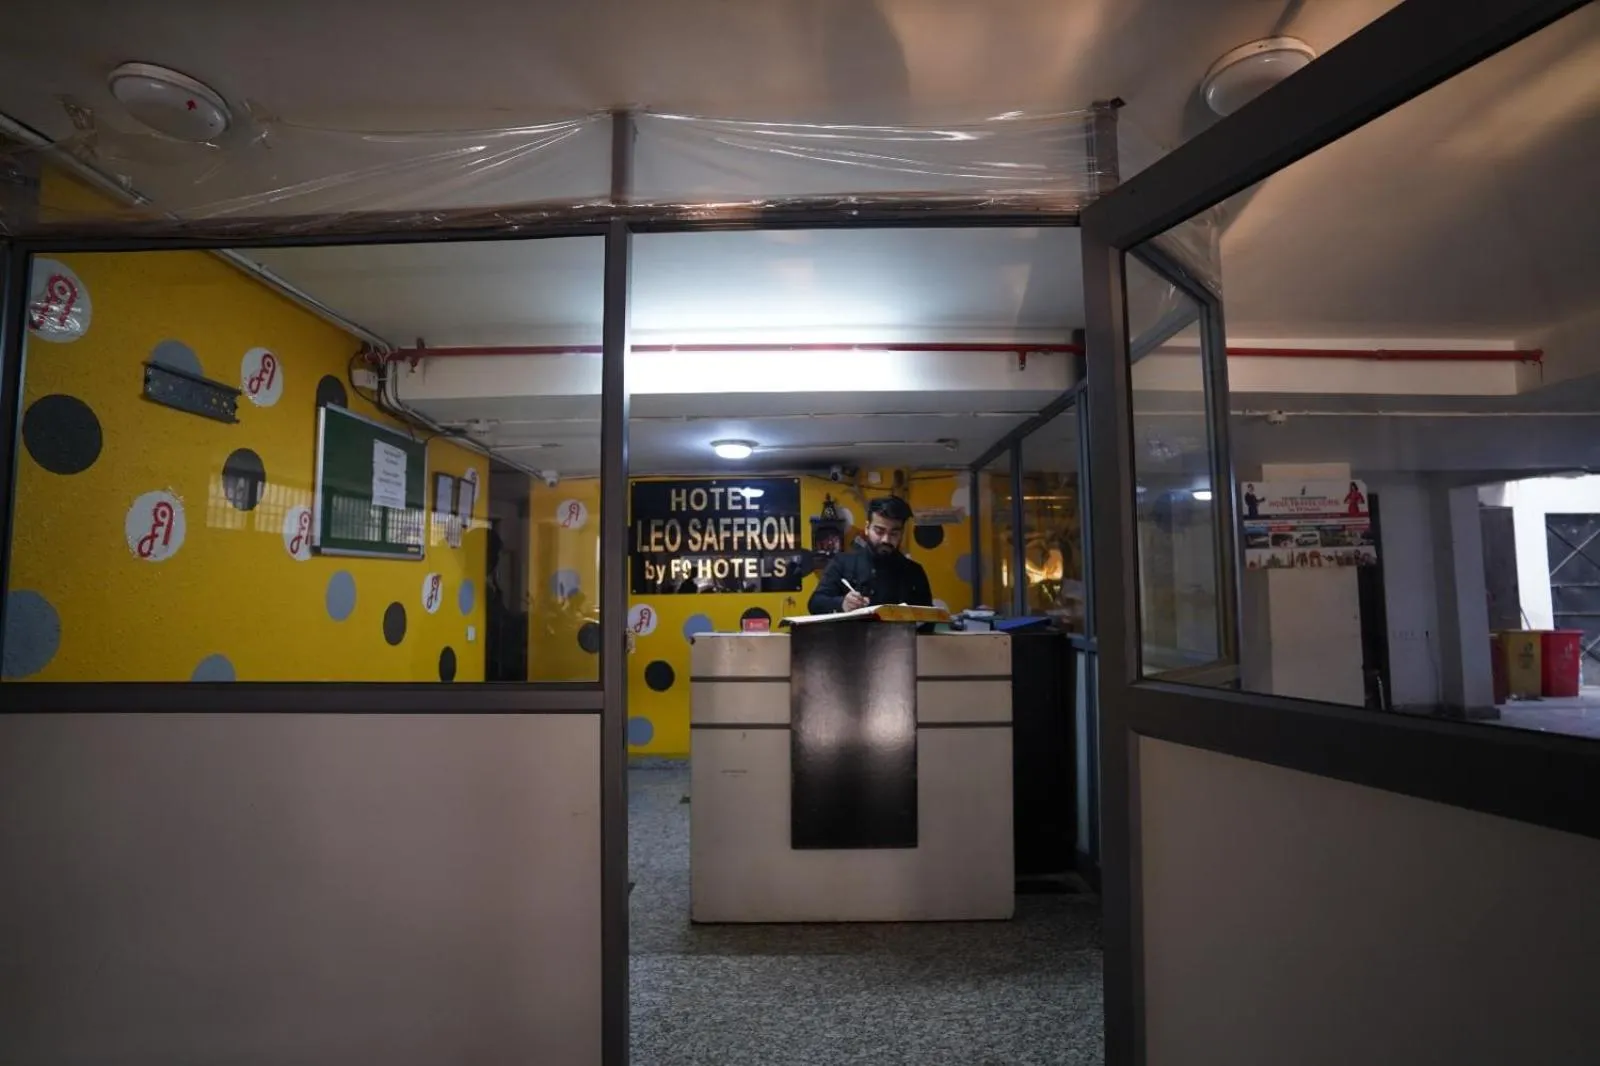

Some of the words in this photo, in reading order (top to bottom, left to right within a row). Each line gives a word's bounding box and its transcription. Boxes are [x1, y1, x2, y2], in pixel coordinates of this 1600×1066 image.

[670, 488, 761, 511] HOTEL
[636, 518, 682, 553] LEO
[688, 516, 795, 552] SAFFRON
[645, 560, 666, 585] by
[697, 557, 788, 579] HOTELS
